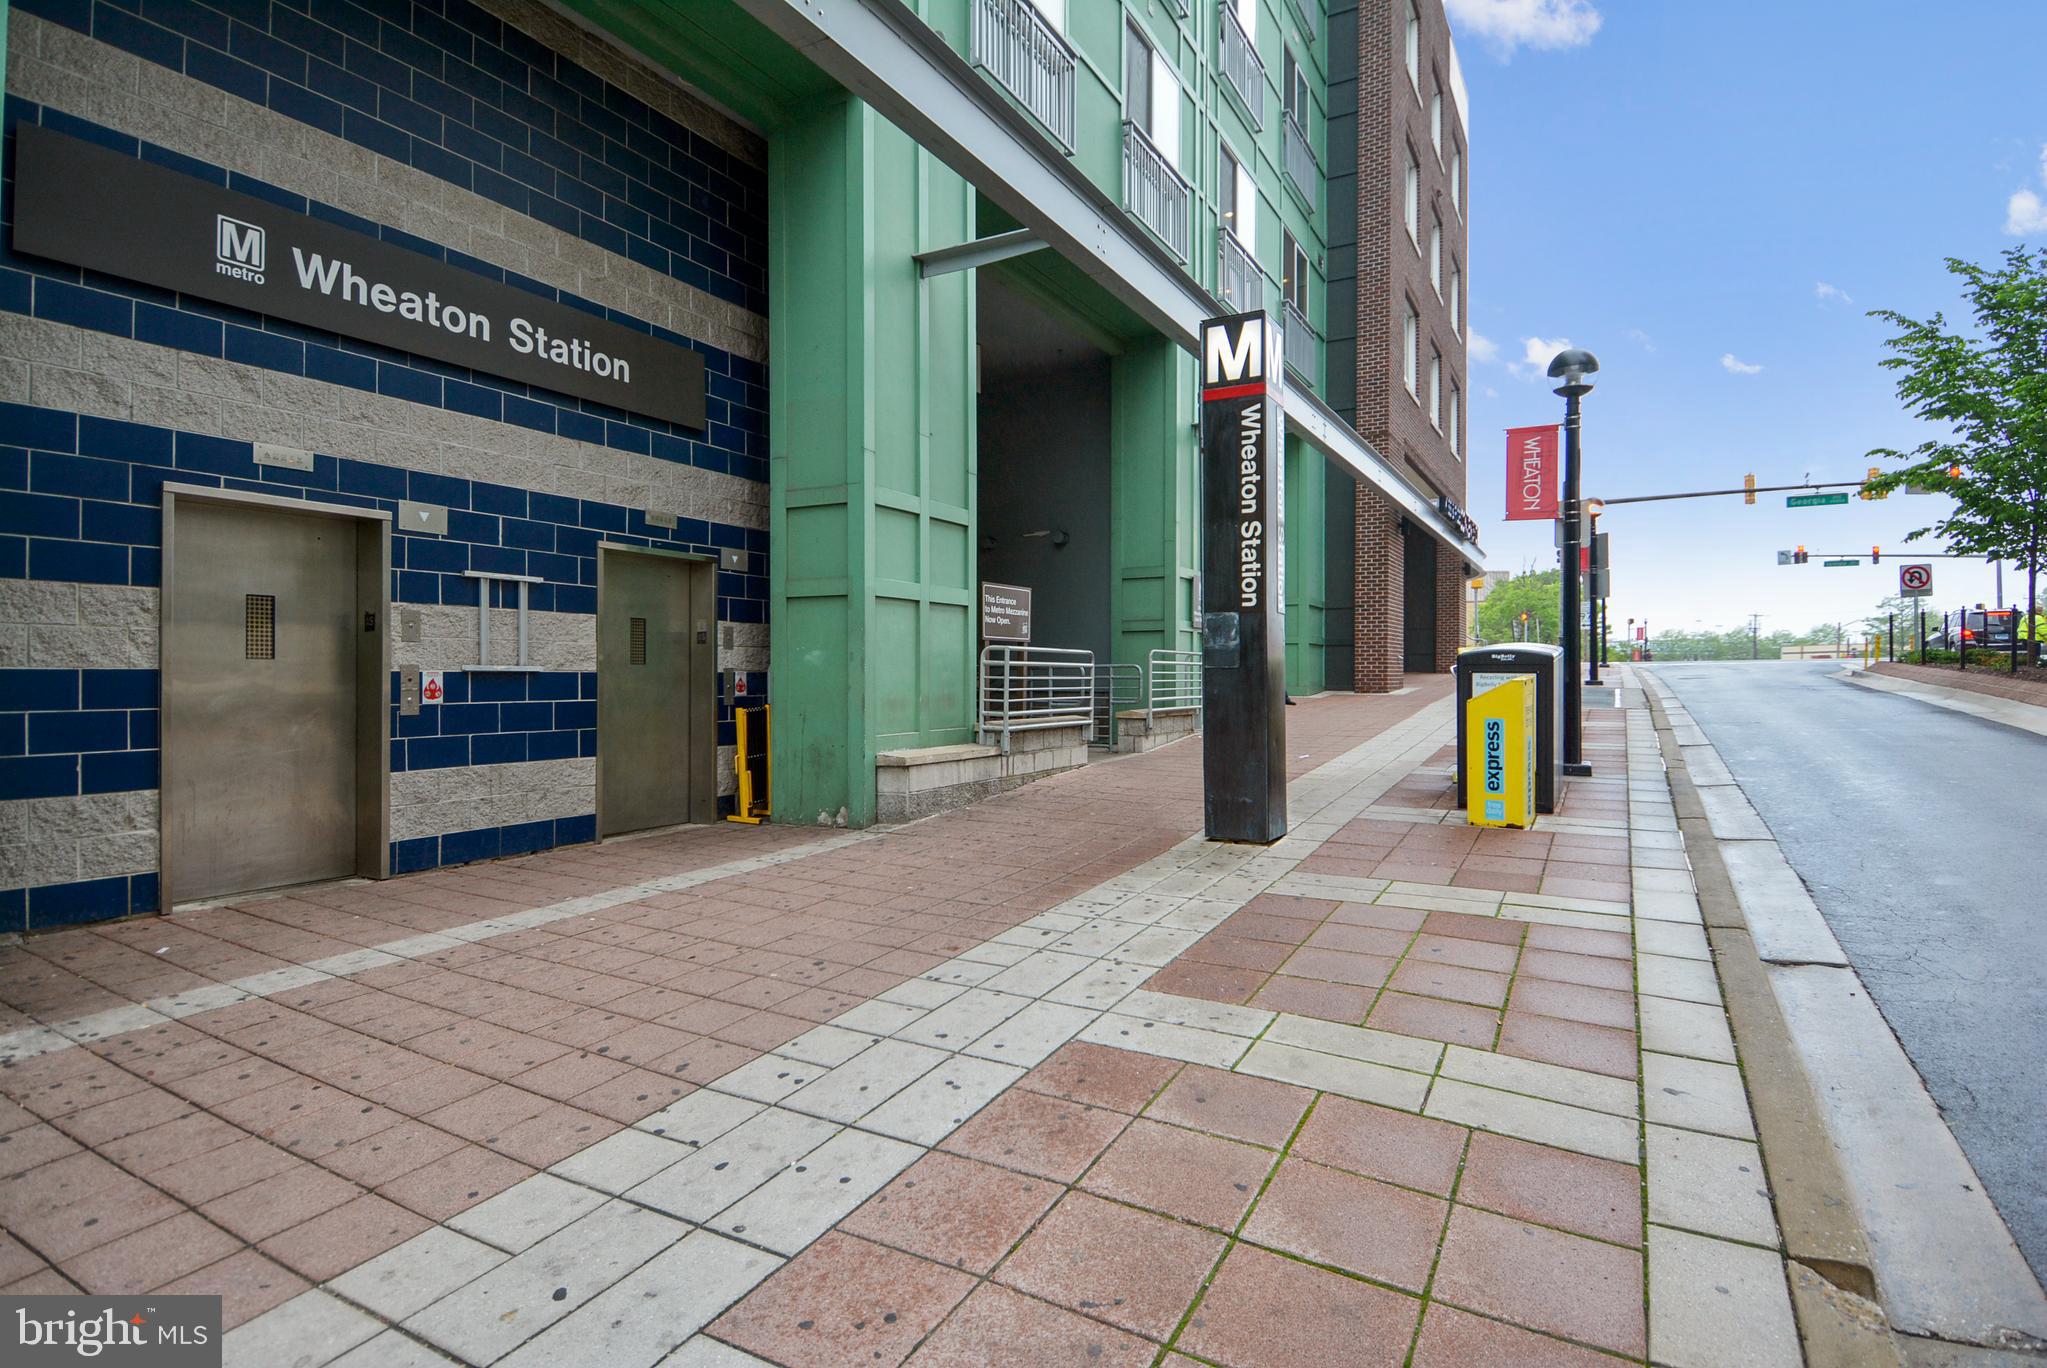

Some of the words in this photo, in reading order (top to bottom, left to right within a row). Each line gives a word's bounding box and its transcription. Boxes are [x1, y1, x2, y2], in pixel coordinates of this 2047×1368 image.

[216, 262, 265, 285] metro
[222, 220, 261, 266] M
[291, 246, 490, 342] Wheaton
[508, 317, 630, 383] Station
[1206, 318, 1263, 385] M
[1266, 322, 1283, 388] M
[1241, 403, 1261, 513] Wheaton
[1523, 436, 1541, 510] WHEATON
[1791, 497, 1826, 506] Georgia
[1241, 521, 1262, 608] Station
[985, 594, 996, 603] This
[996, 596, 1017, 605] Entrance
[991, 606, 1005, 614] Metro
[1487, 721, 1503, 791] express
